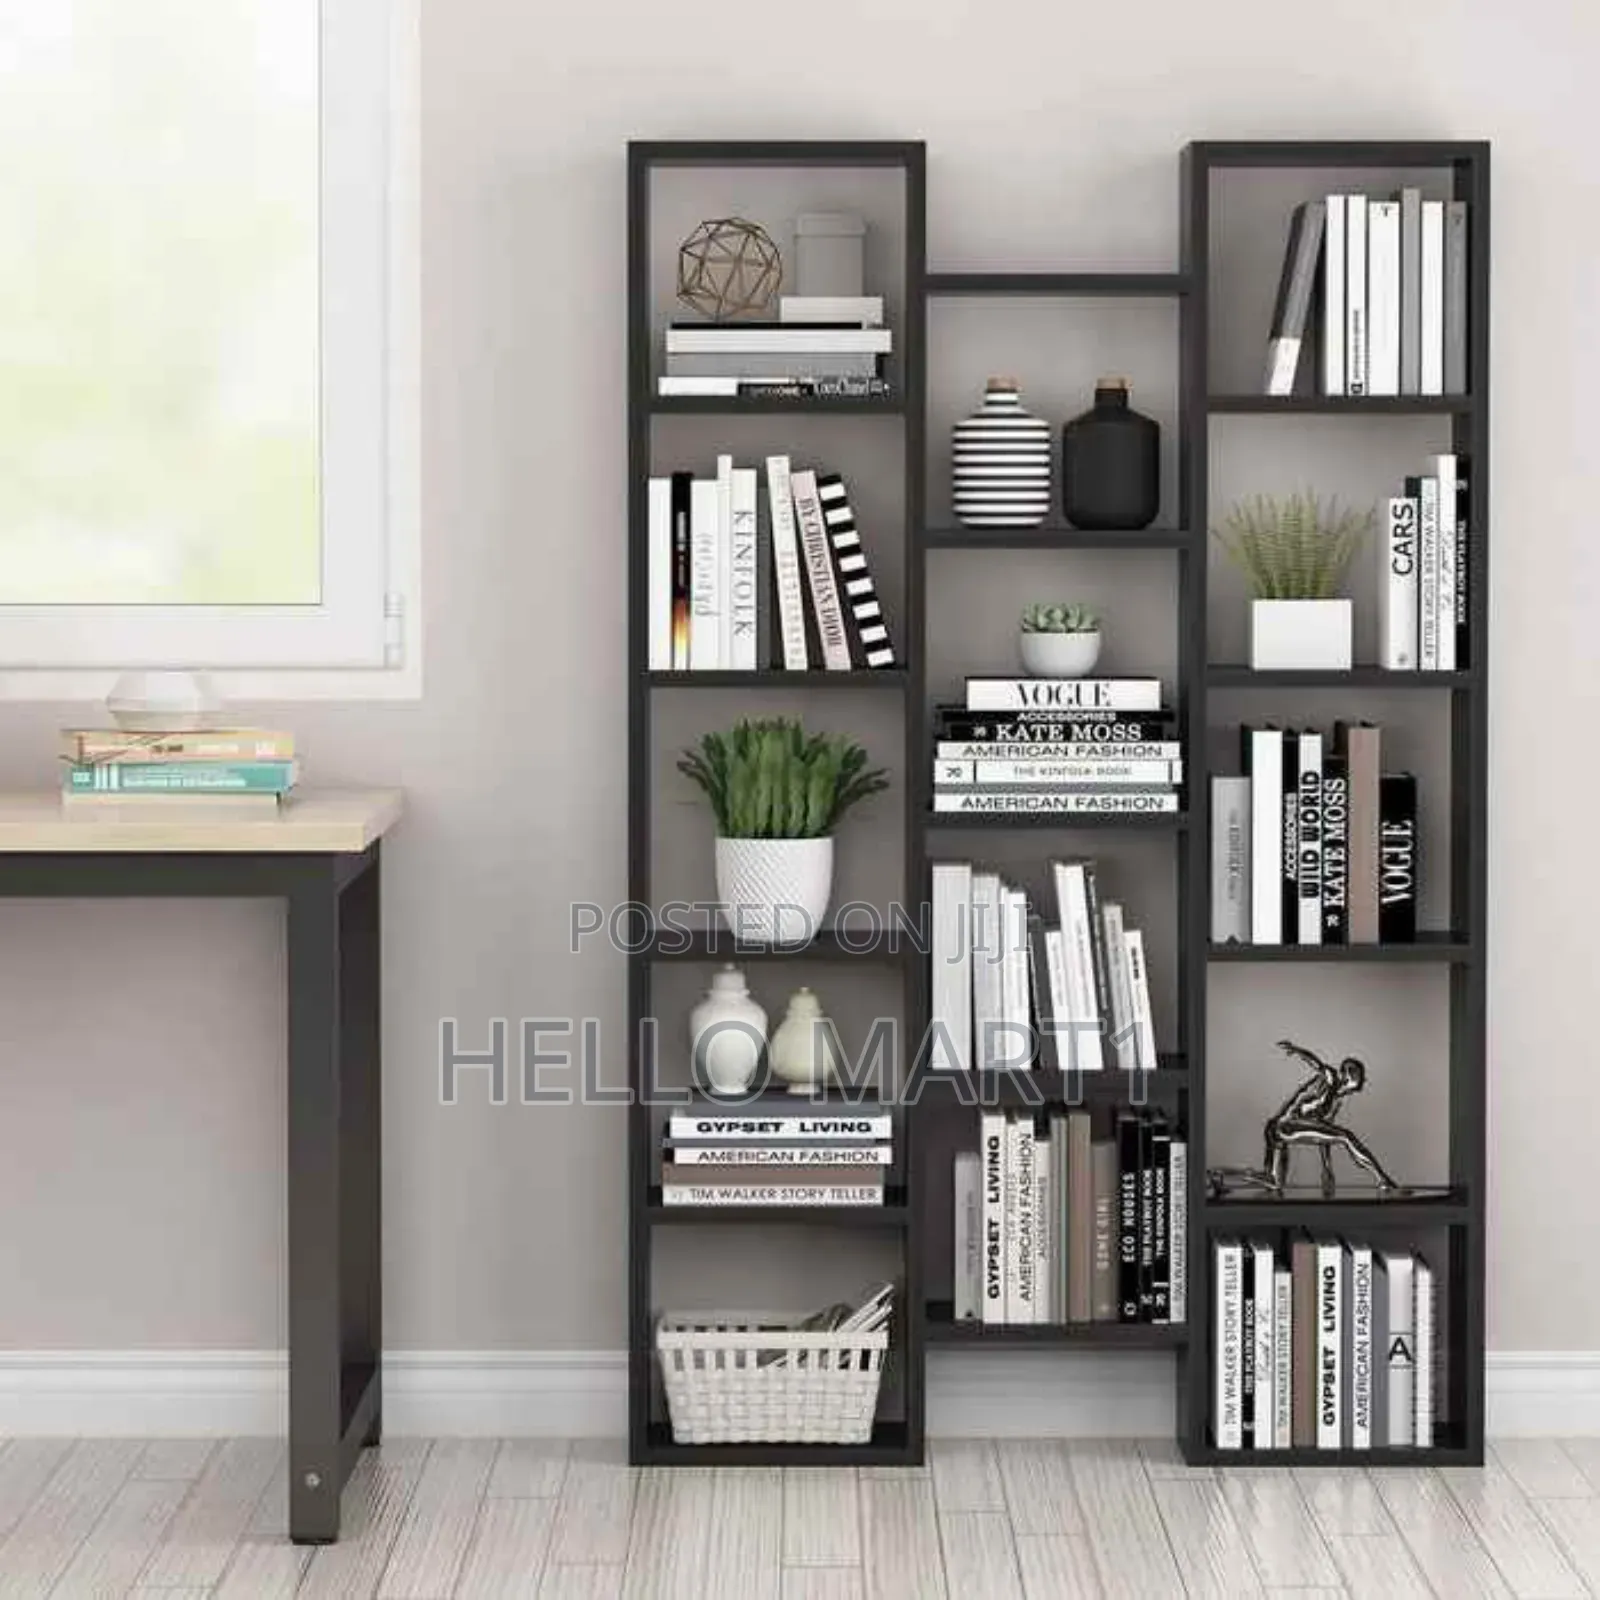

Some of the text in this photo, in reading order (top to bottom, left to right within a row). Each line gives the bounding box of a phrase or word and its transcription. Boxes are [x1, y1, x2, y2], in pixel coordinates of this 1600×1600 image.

[734, 511, 753, 637] KINFOLK
[1392, 504, 1413, 575] CARS
[1018, 683, 1111, 706] VOGUE
[962, 745, 1162, 757] AMERICAN FASHION
[996, 724, 1141, 741] KATE MOSS
[961, 797, 1163, 810] AMERICAN FASHION
[1302, 771, 1319, 898] WILD WORLD
[1324, 778, 1345, 907] KATE MOSS
[1381, 820, 1412, 904] VOGUE
[696, 1122, 872, 1133] GYPSET LIVING
[698, 1151, 879, 1163] AMERICAN FASHION
[689, 1188, 876, 1200] TIM WALKER STORY TELLER
[988, 1136, 1000, 1299] GYPSET LIVING
[1020, 1133, 1032, 1301] AMERICAN FASHION
[1122, 1236, 1135, 1262] ECO
[1225, 1255, 1237, 1425] TIM WALKER STORY TELLER
[1323, 1266, 1335, 1426] GYPSET LIVING
[1357, 1263, 1369, 1428] AMERICAN FASHION
[1388, 1337, 1411, 1361] A
